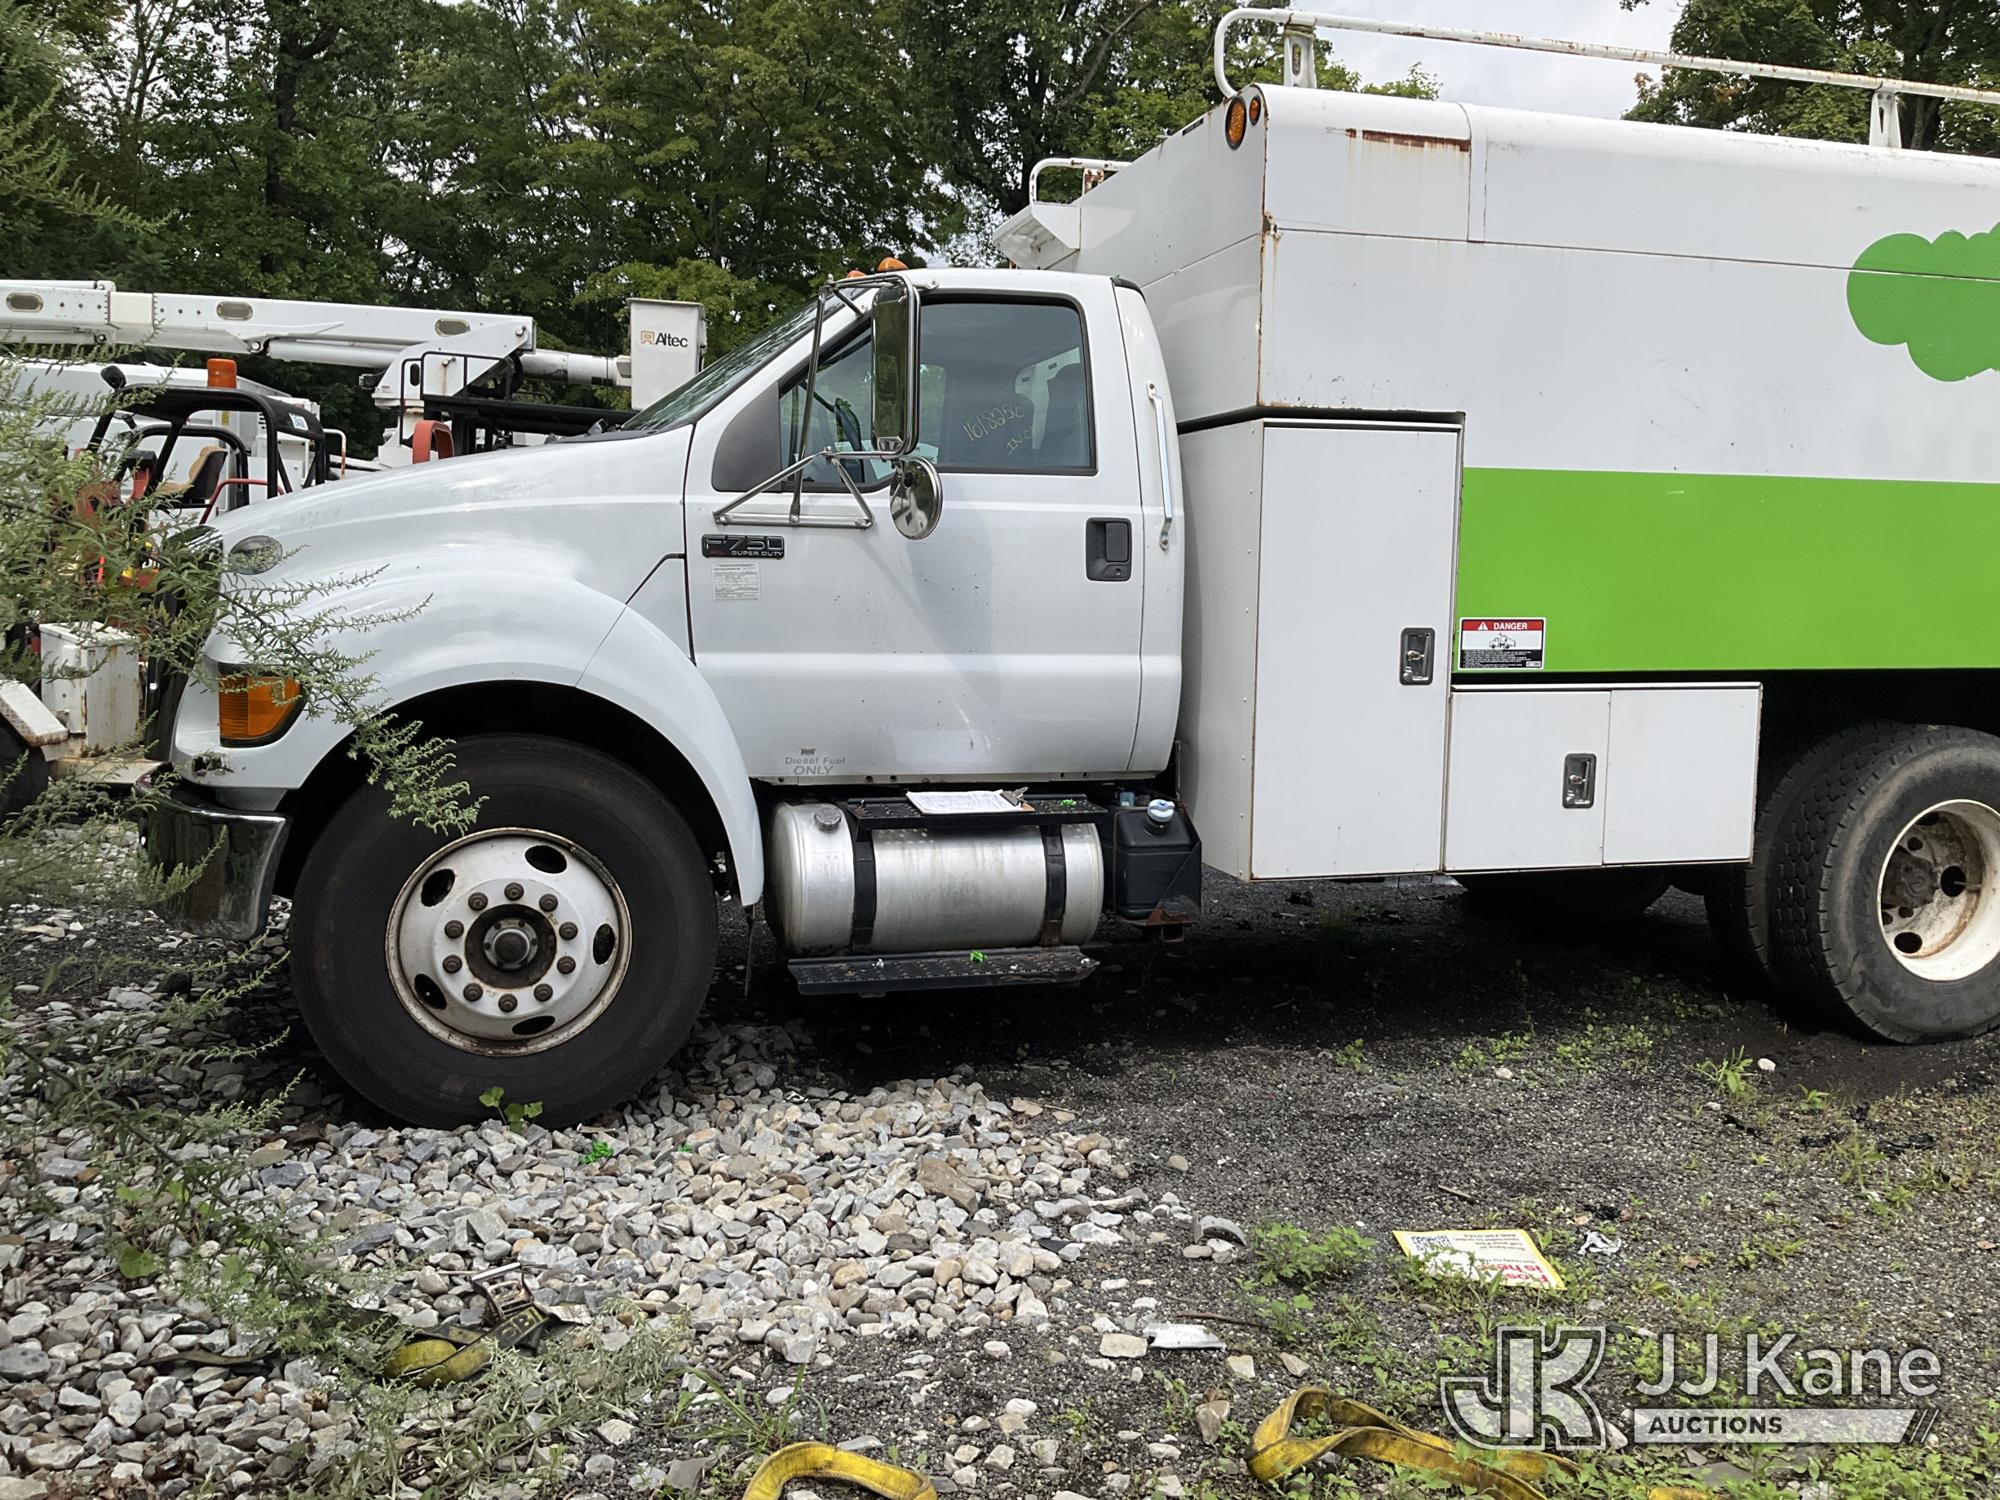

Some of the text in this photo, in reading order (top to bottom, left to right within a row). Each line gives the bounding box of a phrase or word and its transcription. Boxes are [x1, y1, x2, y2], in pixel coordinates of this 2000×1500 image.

[655, 332, 688, 348] Altec
[1493, 622, 1528, 630] DANGER
[784, 756, 846, 765] Diesel Fuel
[793, 765, 834, 775] ONLY
